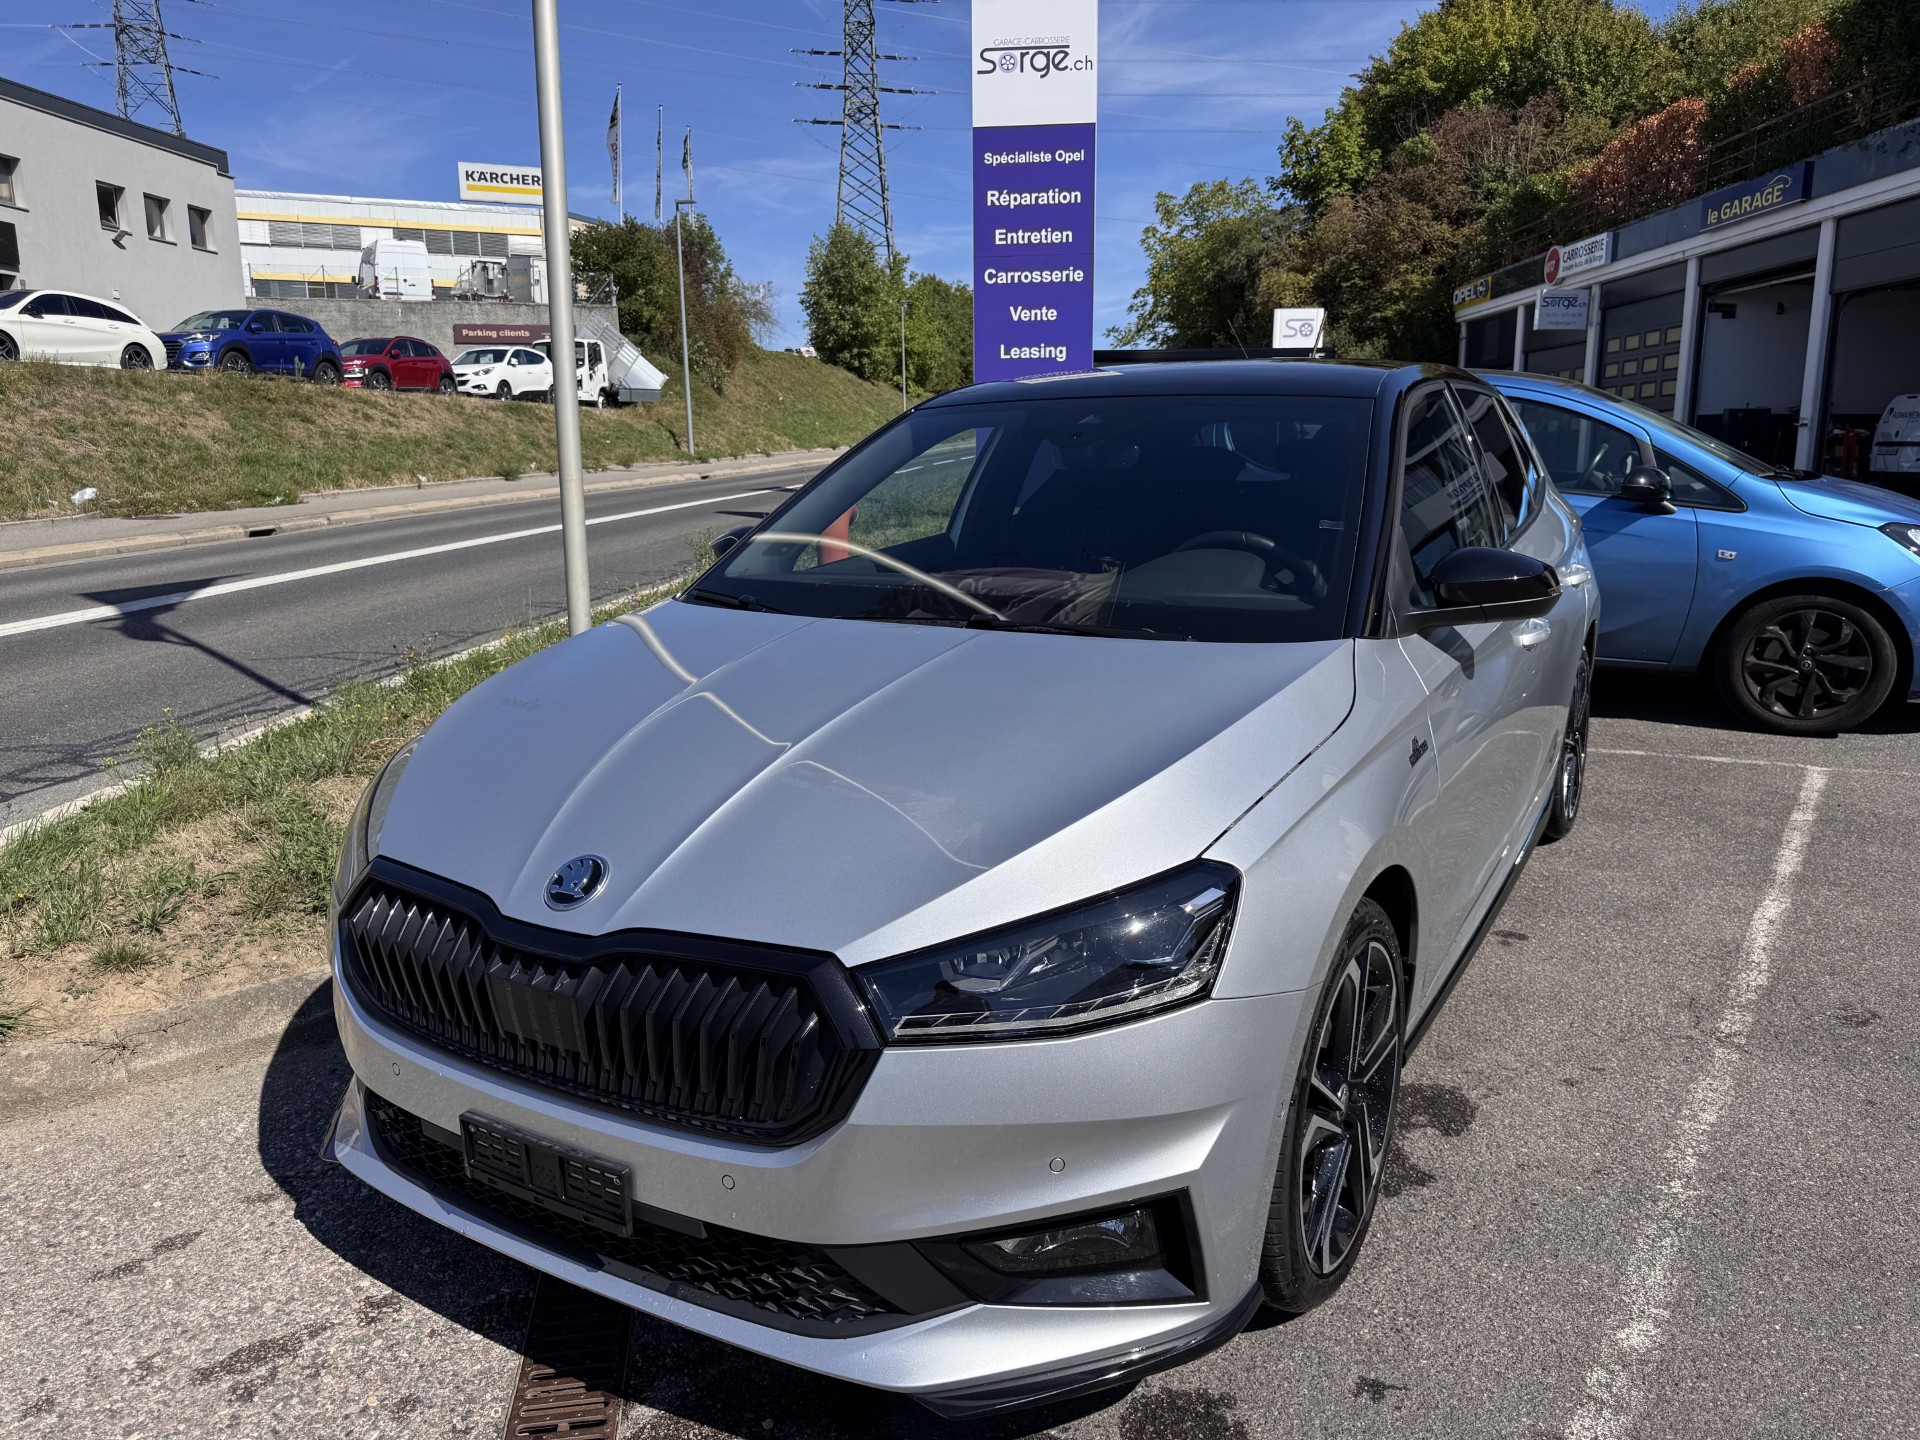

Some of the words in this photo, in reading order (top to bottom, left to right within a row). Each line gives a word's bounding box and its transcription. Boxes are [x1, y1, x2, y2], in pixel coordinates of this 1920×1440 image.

[994, 36, 1070, 46] GARAGE-CARROSSERIE
[984, 151, 1052, 167] Spécialiste
[1055, 149, 1085, 165] Opel
[465, 170, 541, 186] KÄRCHER
[987, 188, 1082, 210] Réparation
[1707, 208, 1718, 225] le
[1720, 184, 1784, 220] GARAGE
[995, 228, 1073, 245] Entretien
[1562, 238, 1605, 264] CARROSSERIE
[984, 266, 1084, 285] Carrosserie
[1453, 285, 1477, 305] OPEL
[1009, 305, 1058, 322] Vente
[462, 329, 498, 338] Parking
[499, 329, 531, 337] clients
[1000, 343, 1067, 362] Leasing
